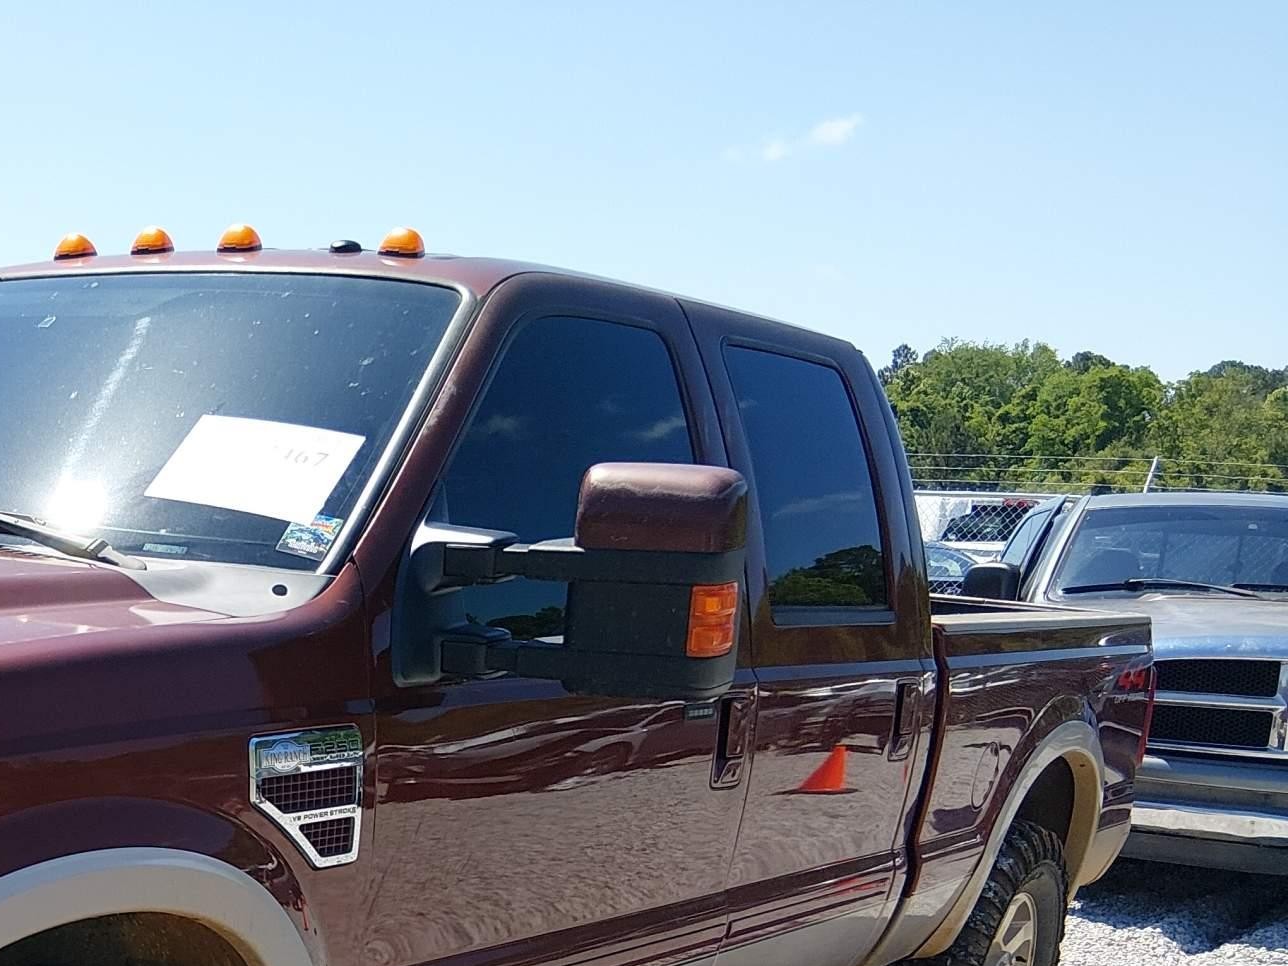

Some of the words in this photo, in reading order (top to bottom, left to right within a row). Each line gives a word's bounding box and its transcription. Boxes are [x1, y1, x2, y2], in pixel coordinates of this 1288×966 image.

[263, 750, 283, 766] KING
[303, 811, 329, 820] POWER
[329, 806, 357, 816] STROKE
